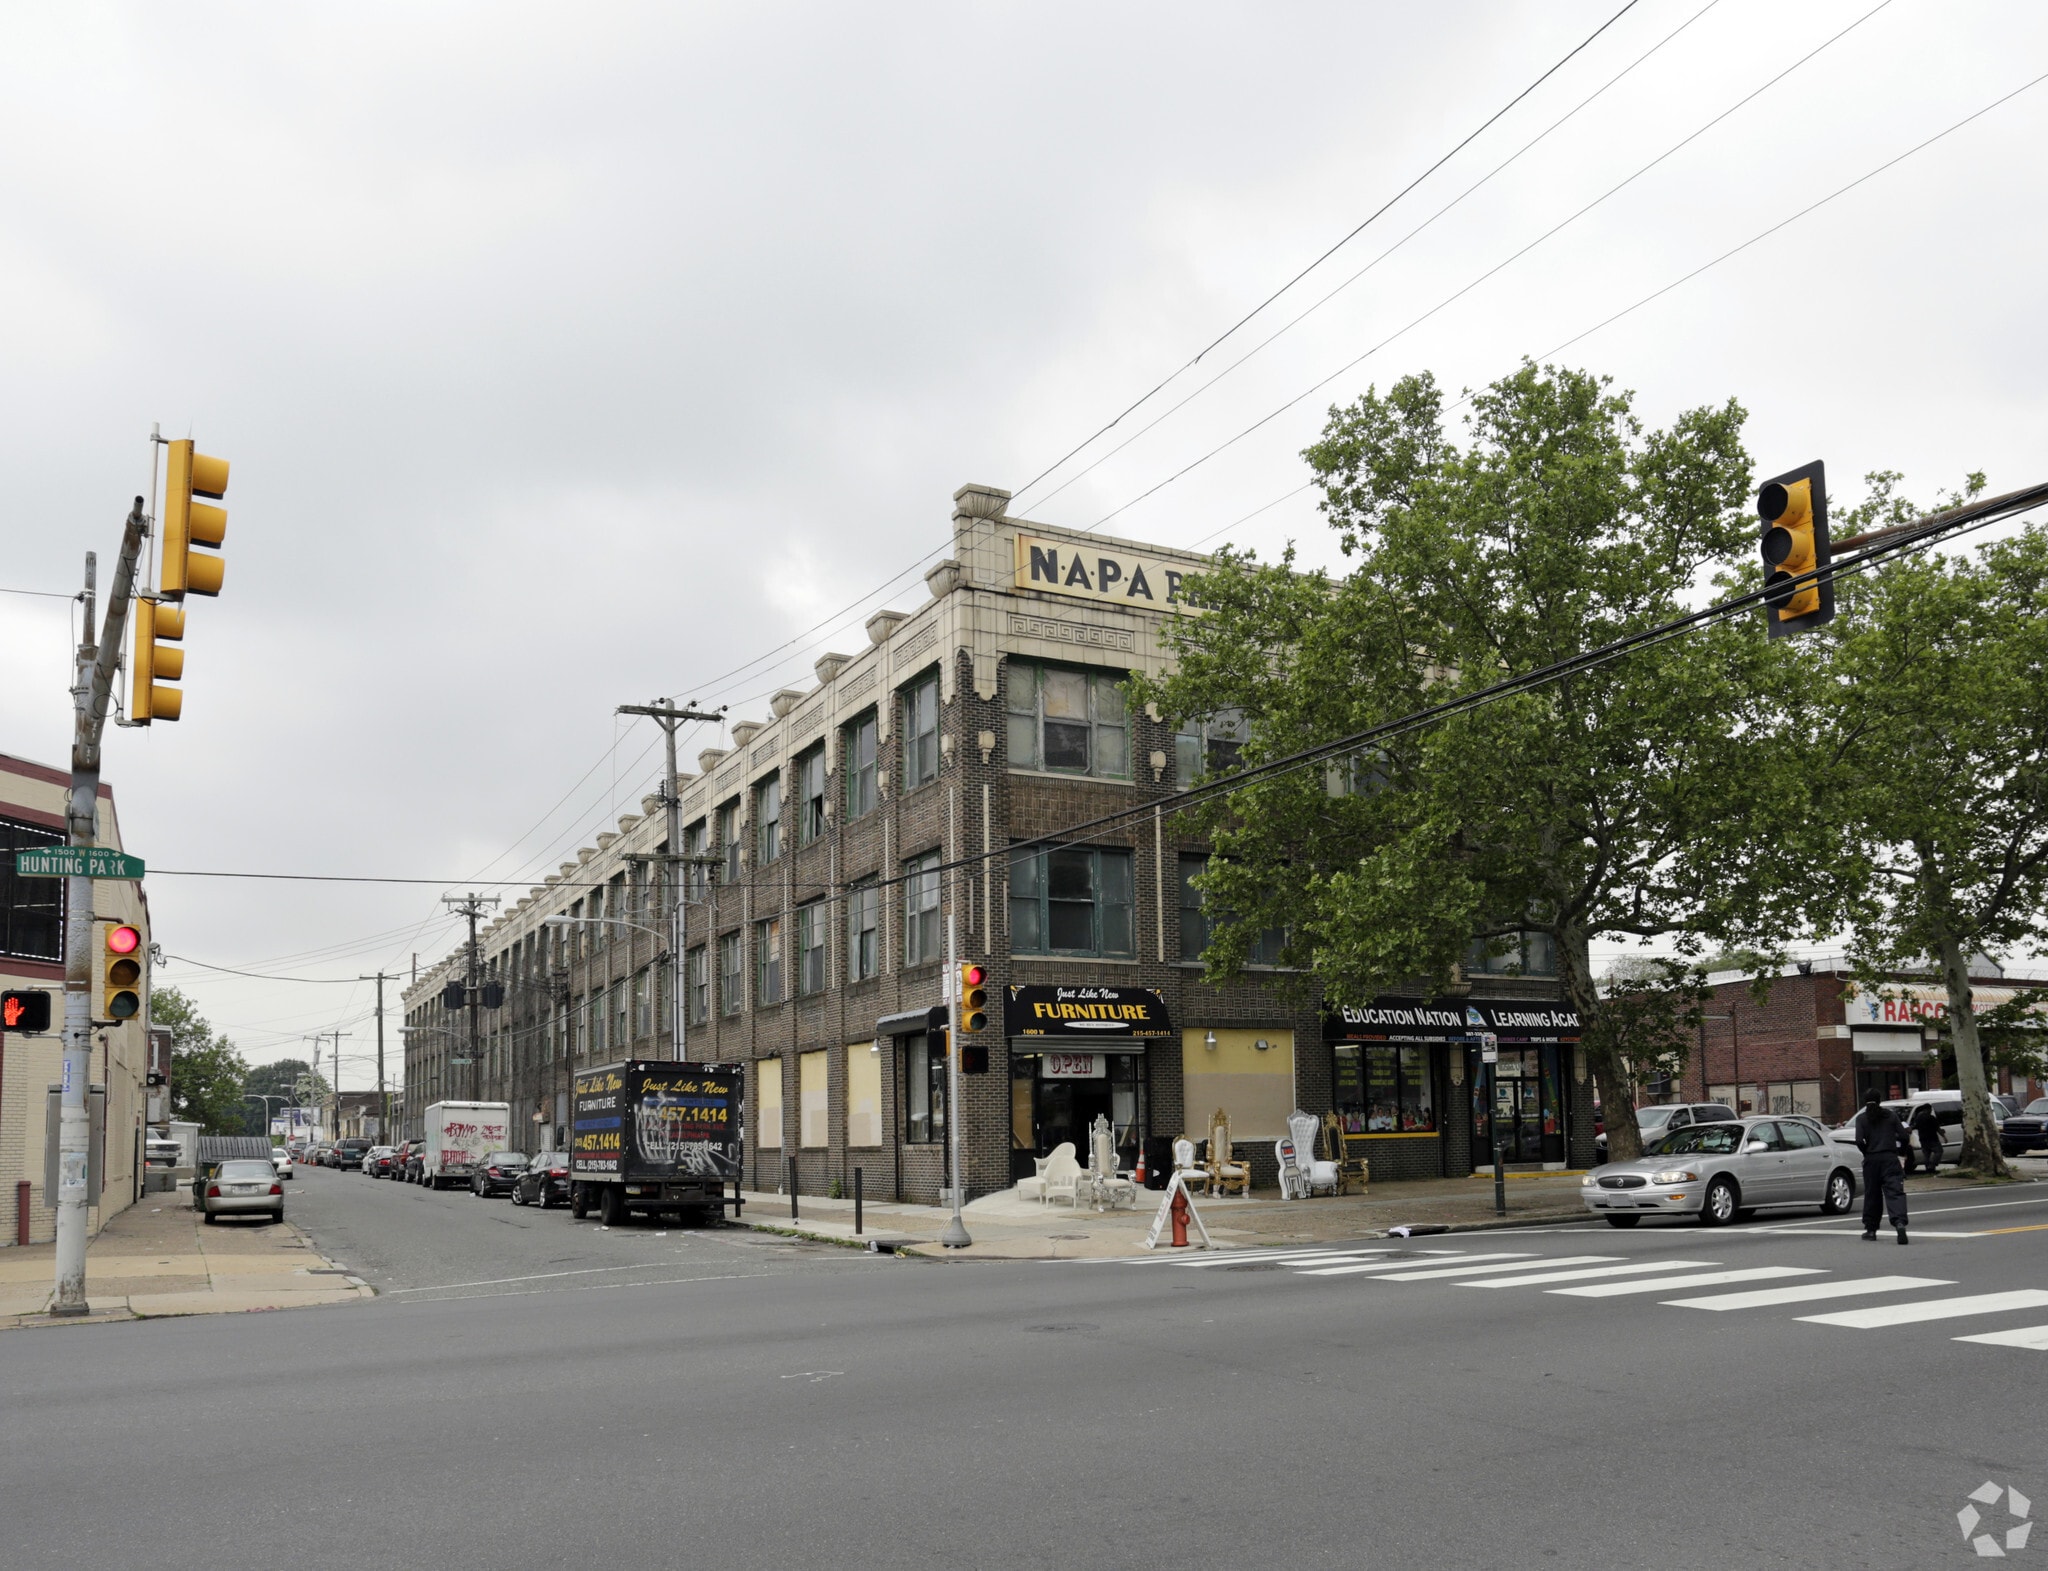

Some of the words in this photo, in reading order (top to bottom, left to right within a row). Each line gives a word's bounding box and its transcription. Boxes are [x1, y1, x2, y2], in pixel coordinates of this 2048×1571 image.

[54, 848, 75, 856] 1500
[78, 848, 86, 857] W
[21, 856, 83, 874] HUNTING
[1057, 987, 1076, 1001] Just
[1077, 988, 1098, 999] Like
[1099, 989, 1120, 999] New
[1033, 1003, 1150, 1020] FURNITURE
[1342, 1005, 1415, 1025] EDUCATION
[1414, 1007, 1462, 1027] NATION
[1490, 1009, 1551, 1027] LEARNING
[1050, 1054, 1093, 1074] OPEN
[574, 1078, 588, 1100] Just
[589, 1076, 605, 1093] Like
[606, 1072, 622, 1091] New
[641, 1078, 668, 1094] Just
[670, 1080, 698, 1092] Like
[702, 1081, 728, 1094] New
[579, 1096, 616, 1112] FURNITURE
[582, 1132, 621, 1151] 457.1414
